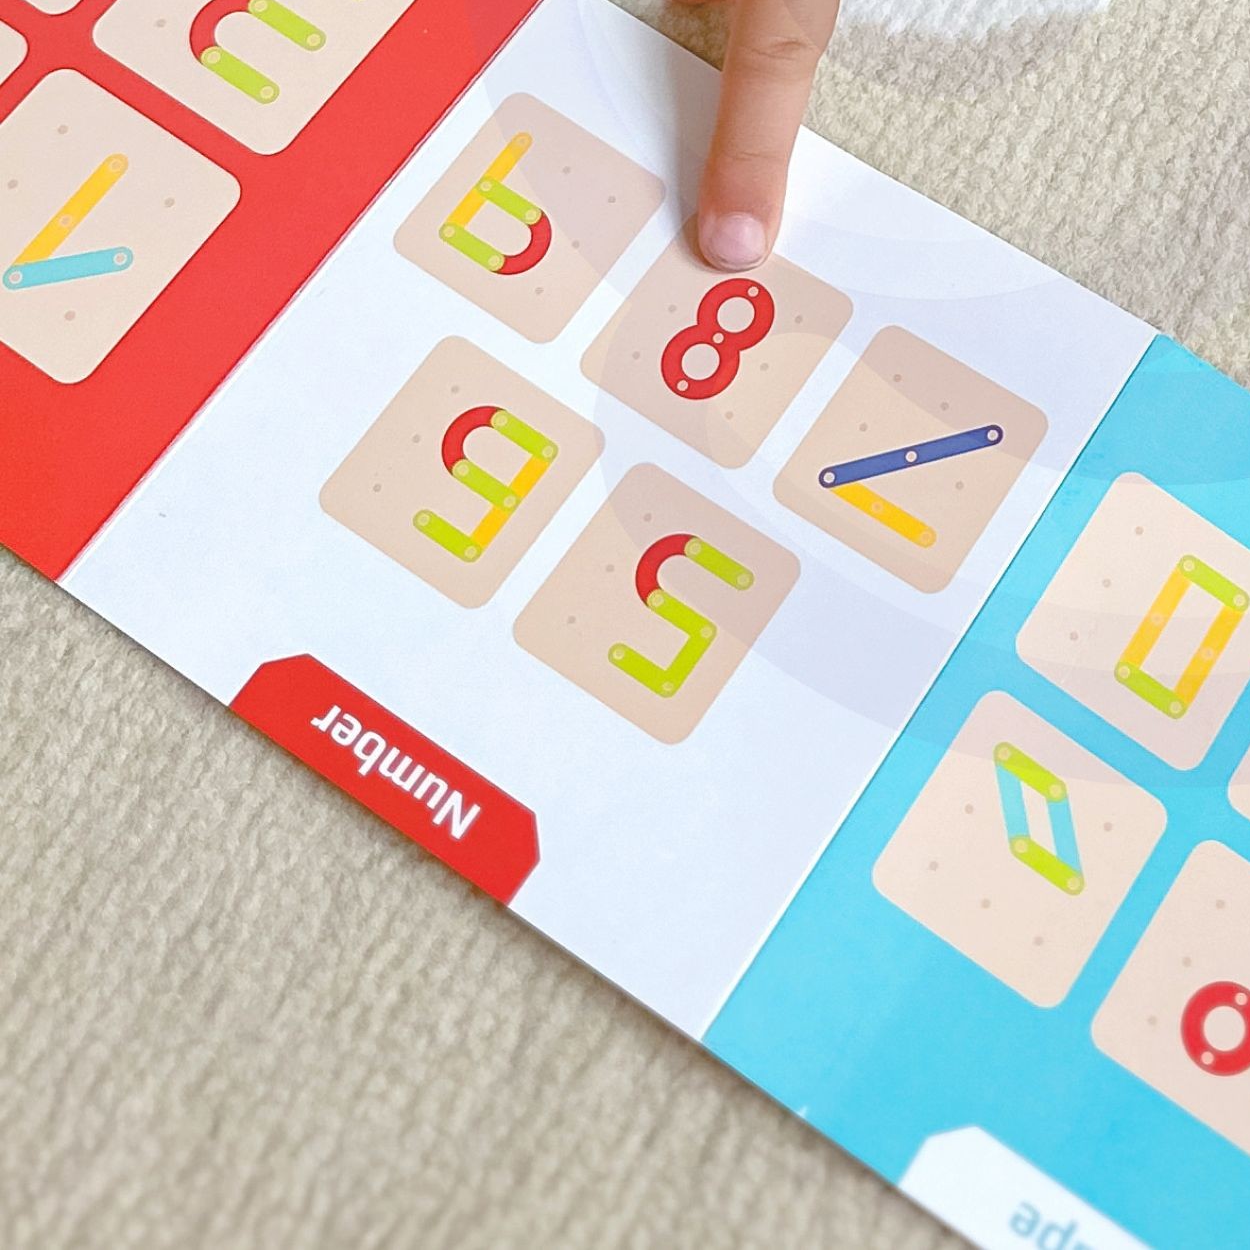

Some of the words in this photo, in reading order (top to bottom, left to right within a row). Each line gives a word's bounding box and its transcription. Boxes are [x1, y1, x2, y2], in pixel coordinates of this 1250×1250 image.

[3, 153, 133, 290] 1
[438, 131, 552, 275] 9
[661, 277, 775, 400] 8
[413, 405, 559, 564] 6
[817, 423, 1004, 549] 7
[608, 533, 756, 698] 5
[310, 704, 481, 840] Number
